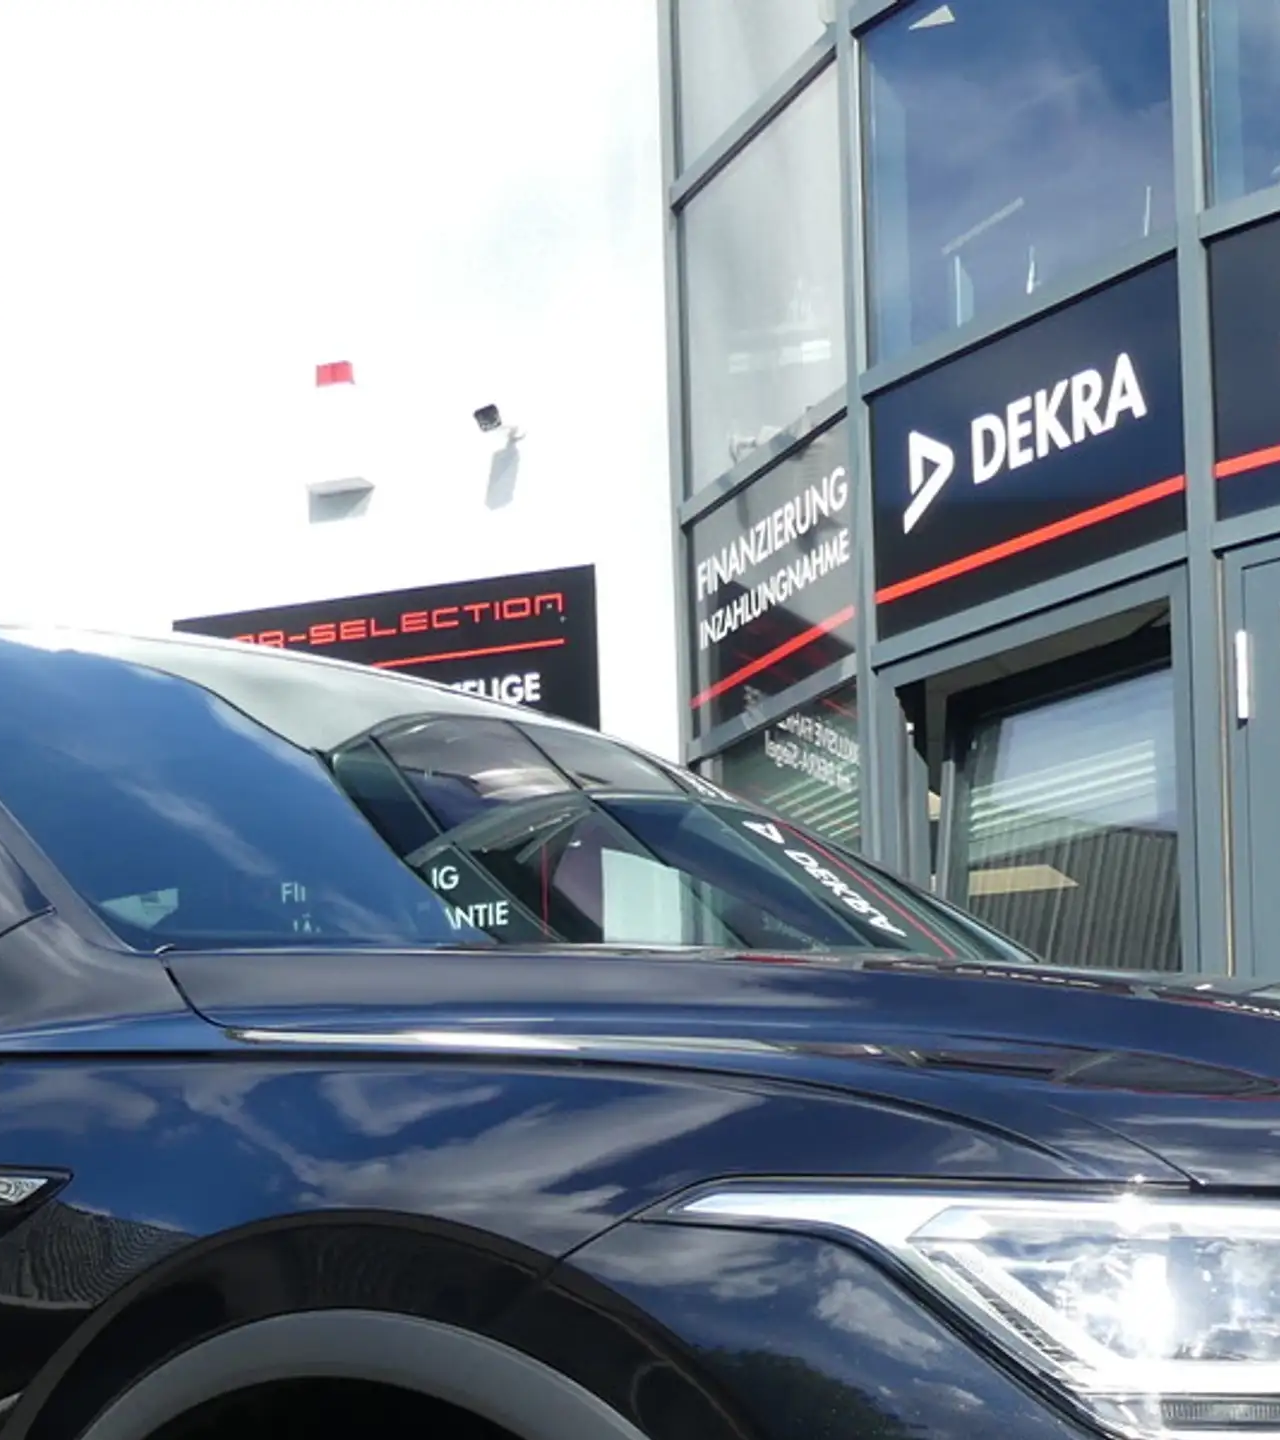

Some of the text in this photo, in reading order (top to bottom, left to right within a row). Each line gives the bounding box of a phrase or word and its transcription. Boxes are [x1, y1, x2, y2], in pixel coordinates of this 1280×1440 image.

[969, 351, 1148, 486] DEKRA
[696, 465, 848, 603] FINANZIERUNG
[699, 528, 851, 652] INZAHLUNGNAHME
